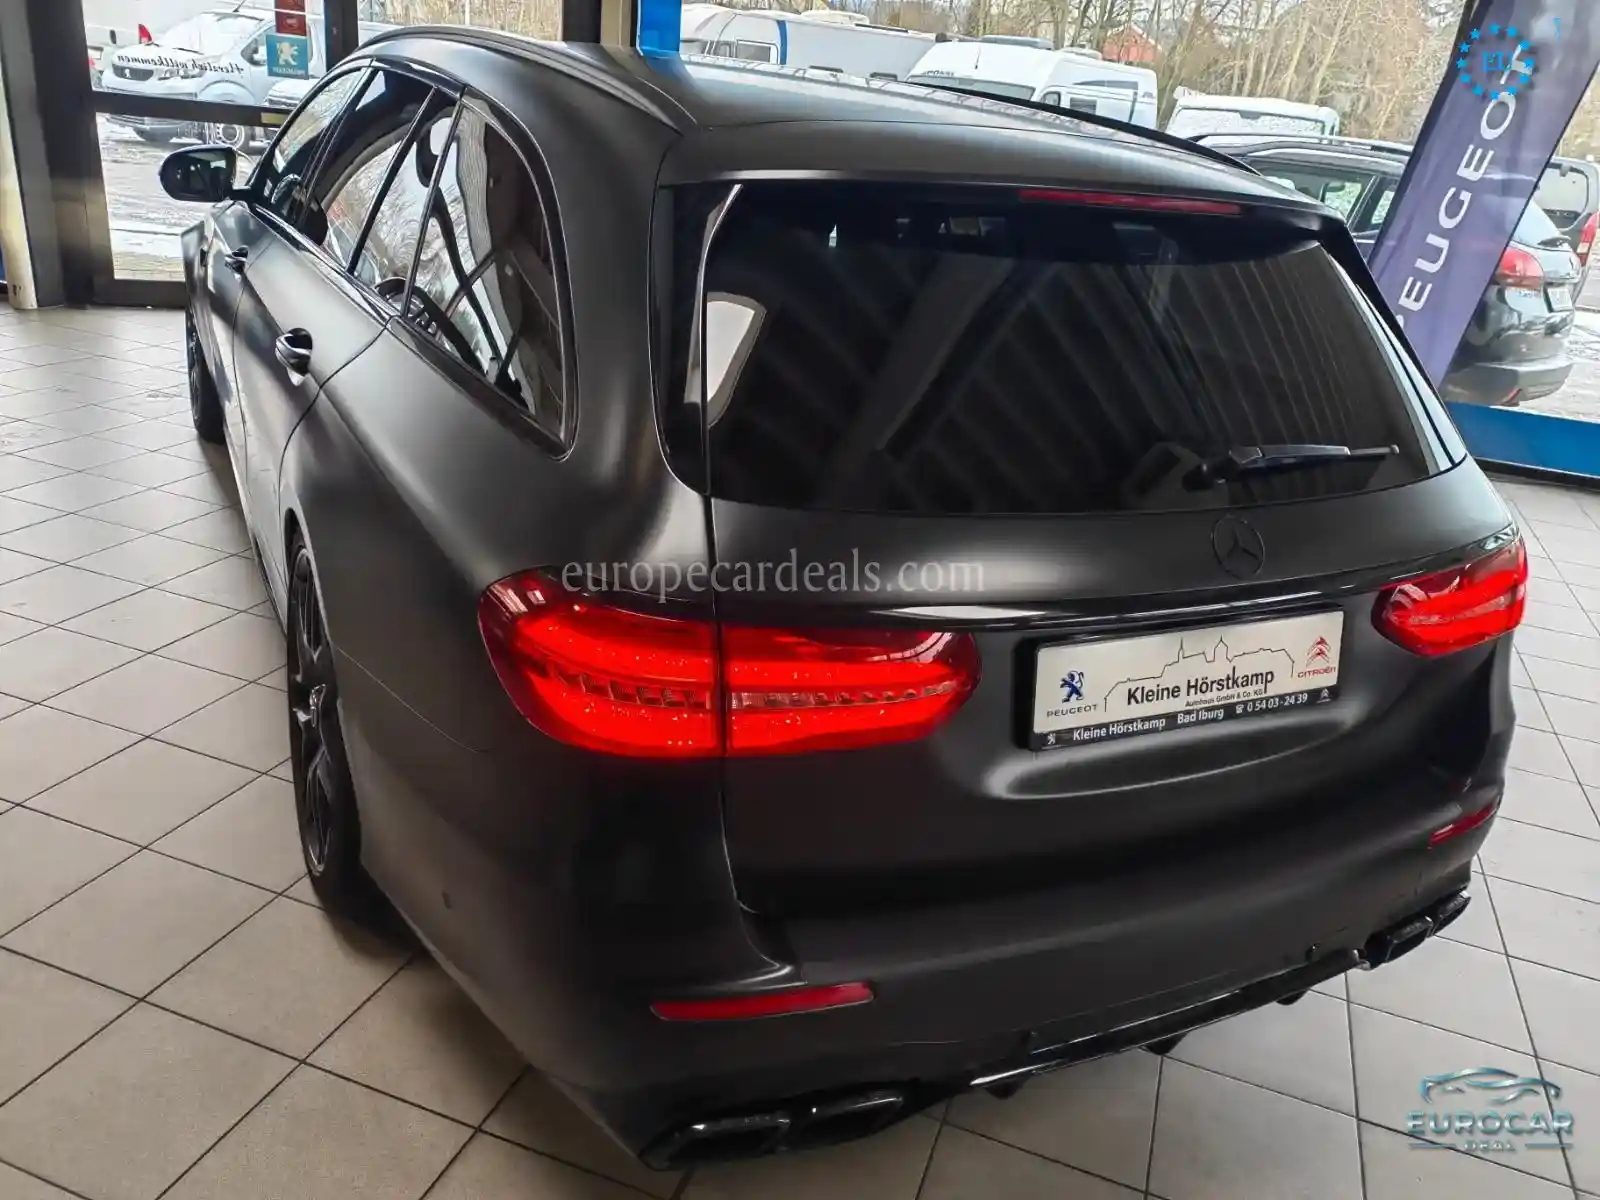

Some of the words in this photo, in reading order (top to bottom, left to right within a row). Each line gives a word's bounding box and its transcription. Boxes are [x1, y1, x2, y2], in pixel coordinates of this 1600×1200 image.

[1127, 683, 1181, 705] Kleine
[1187, 665, 1275, 695] Hörstkamp
[1046, 703, 1098, 718] PEUGEOT
[1073, 727, 1107, 741] Kleine
[1109, 718, 1166, 735] Hörstkamp
[1177, 711, 1197, 724] Bad
[1199, 708, 1224, 722] Iburg
[1247, 702, 1253, 712] 0
[1255, 700, 1266, 710] 54
[1296, 693, 1308, 703] 39
